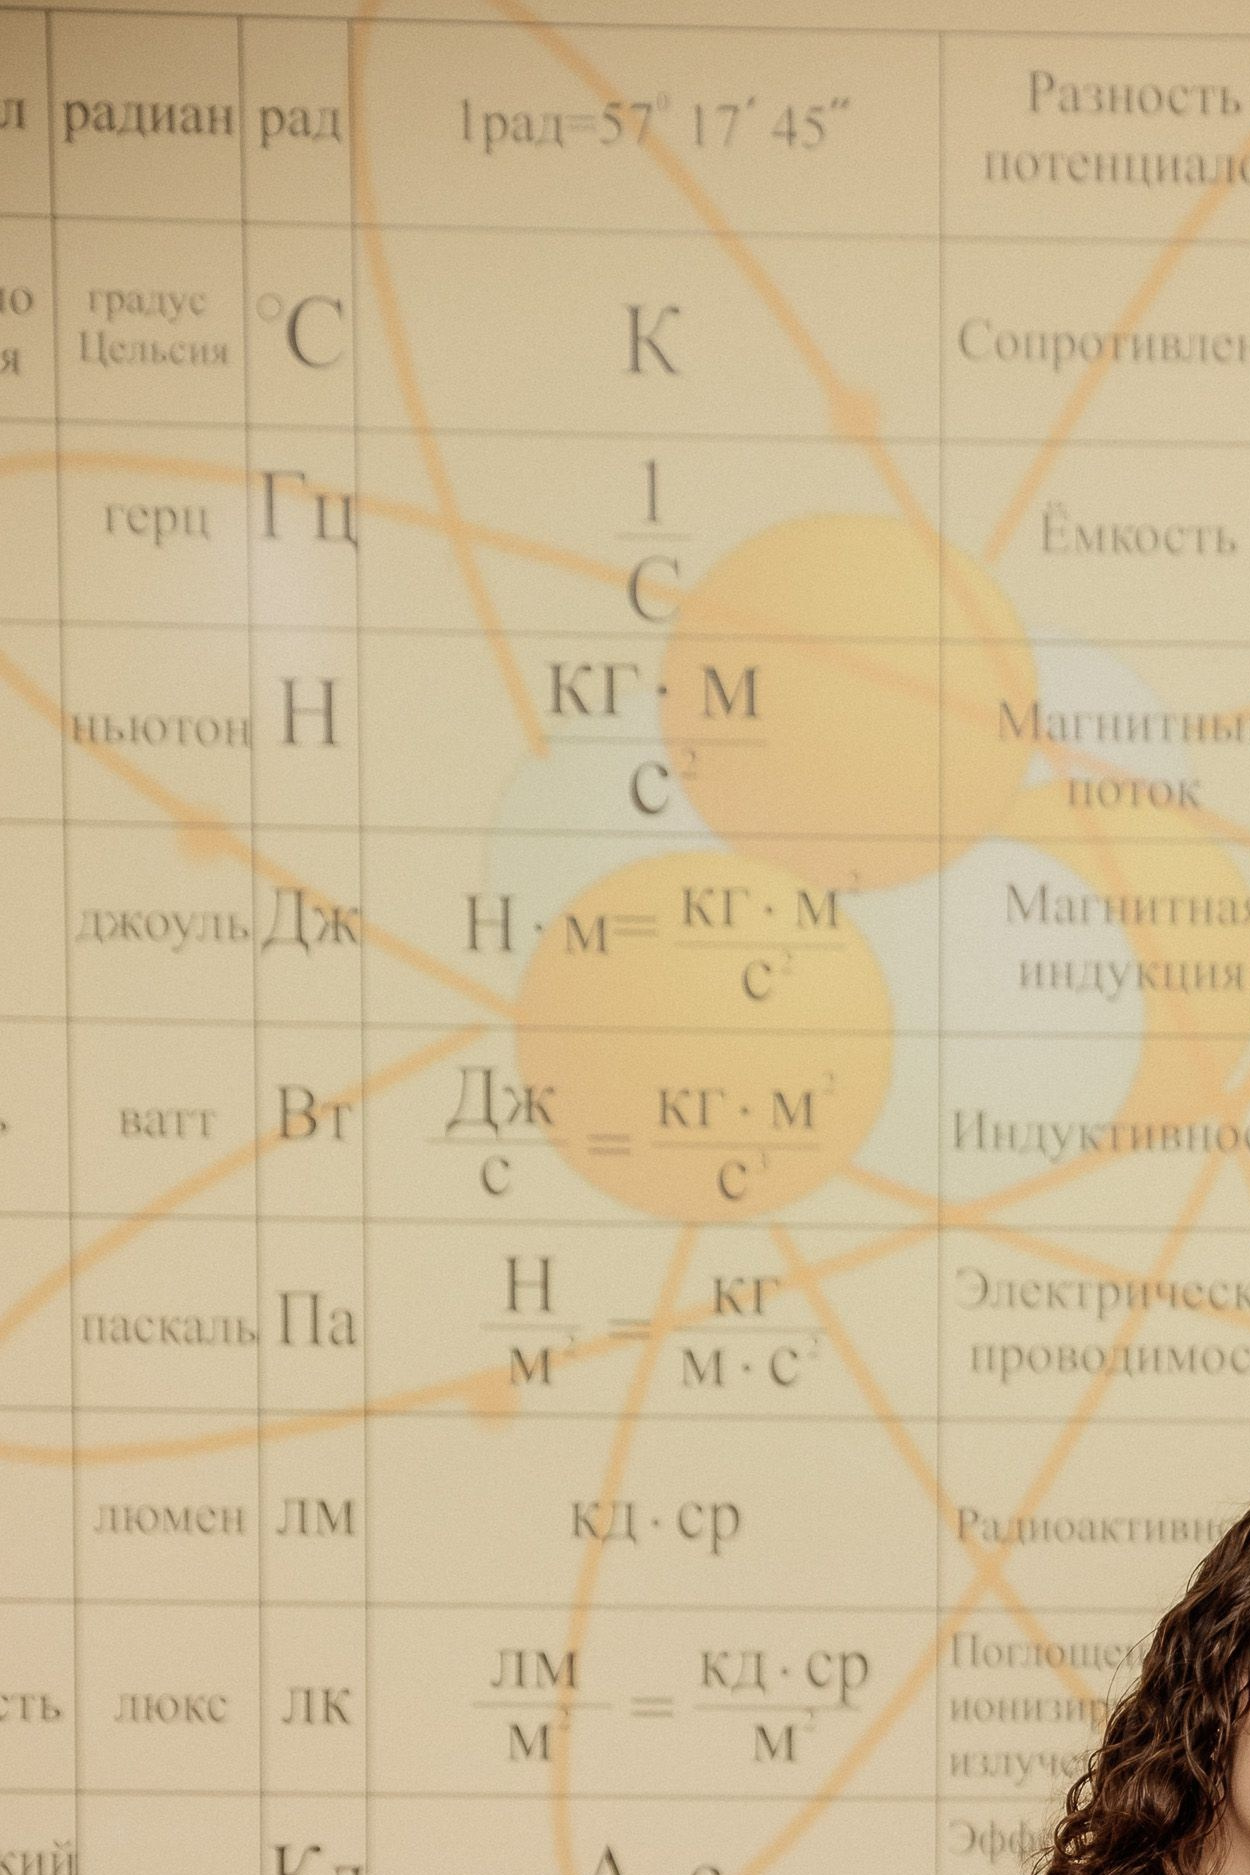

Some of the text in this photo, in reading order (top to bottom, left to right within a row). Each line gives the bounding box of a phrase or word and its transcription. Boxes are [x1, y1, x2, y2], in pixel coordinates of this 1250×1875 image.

[1028, 69, 1242, 116] Разность
[63, 98, 234, 143] радиан
[258, 101, 342, 148] рад
[88, 287, 207, 321] градус
[79, 330, 229, 370] Цельсия
[623, 304, 682, 375] К
[261, 470, 359, 548] Гц
[644, 459, 659, 525] 1
[103, 503, 210, 548] герц
[1041, 500, 1237, 556] Ёмкость
[71, 713, 252, 750] ньютон
[280, 676, 338, 747] Н
[1066, 773, 1201, 812] поток
[76, 907, 249, 954] джоуль
[261, 886, 359, 955] Дж
[1019, 958, 1246, 1001] индукция
[119, 1105, 216, 1139] ватт
[278, 1083, 353, 1142] Вт
[445, 1065, 556, 1138] Дж
[505, 1256, 554, 1313] Н
[712, 1277, 781, 1315] кг
[82, 1311, 258, 1346] паскаль
[278, 1290, 357, 1347] Па
[93, 1503, 245, 1537] люмен
[276, 1497, 356, 1537] лм
[958, 1506, 1228, 1545] Радиоактивн
[490, 1648, 579, 1690] лм
[953, 1632, 1147, 1670] Поглощен
[113, 1690, 228, 1724] люкс
[282, 1687, 351, 1724] лк
[951, 1698, 1107, 1732] ионизир
